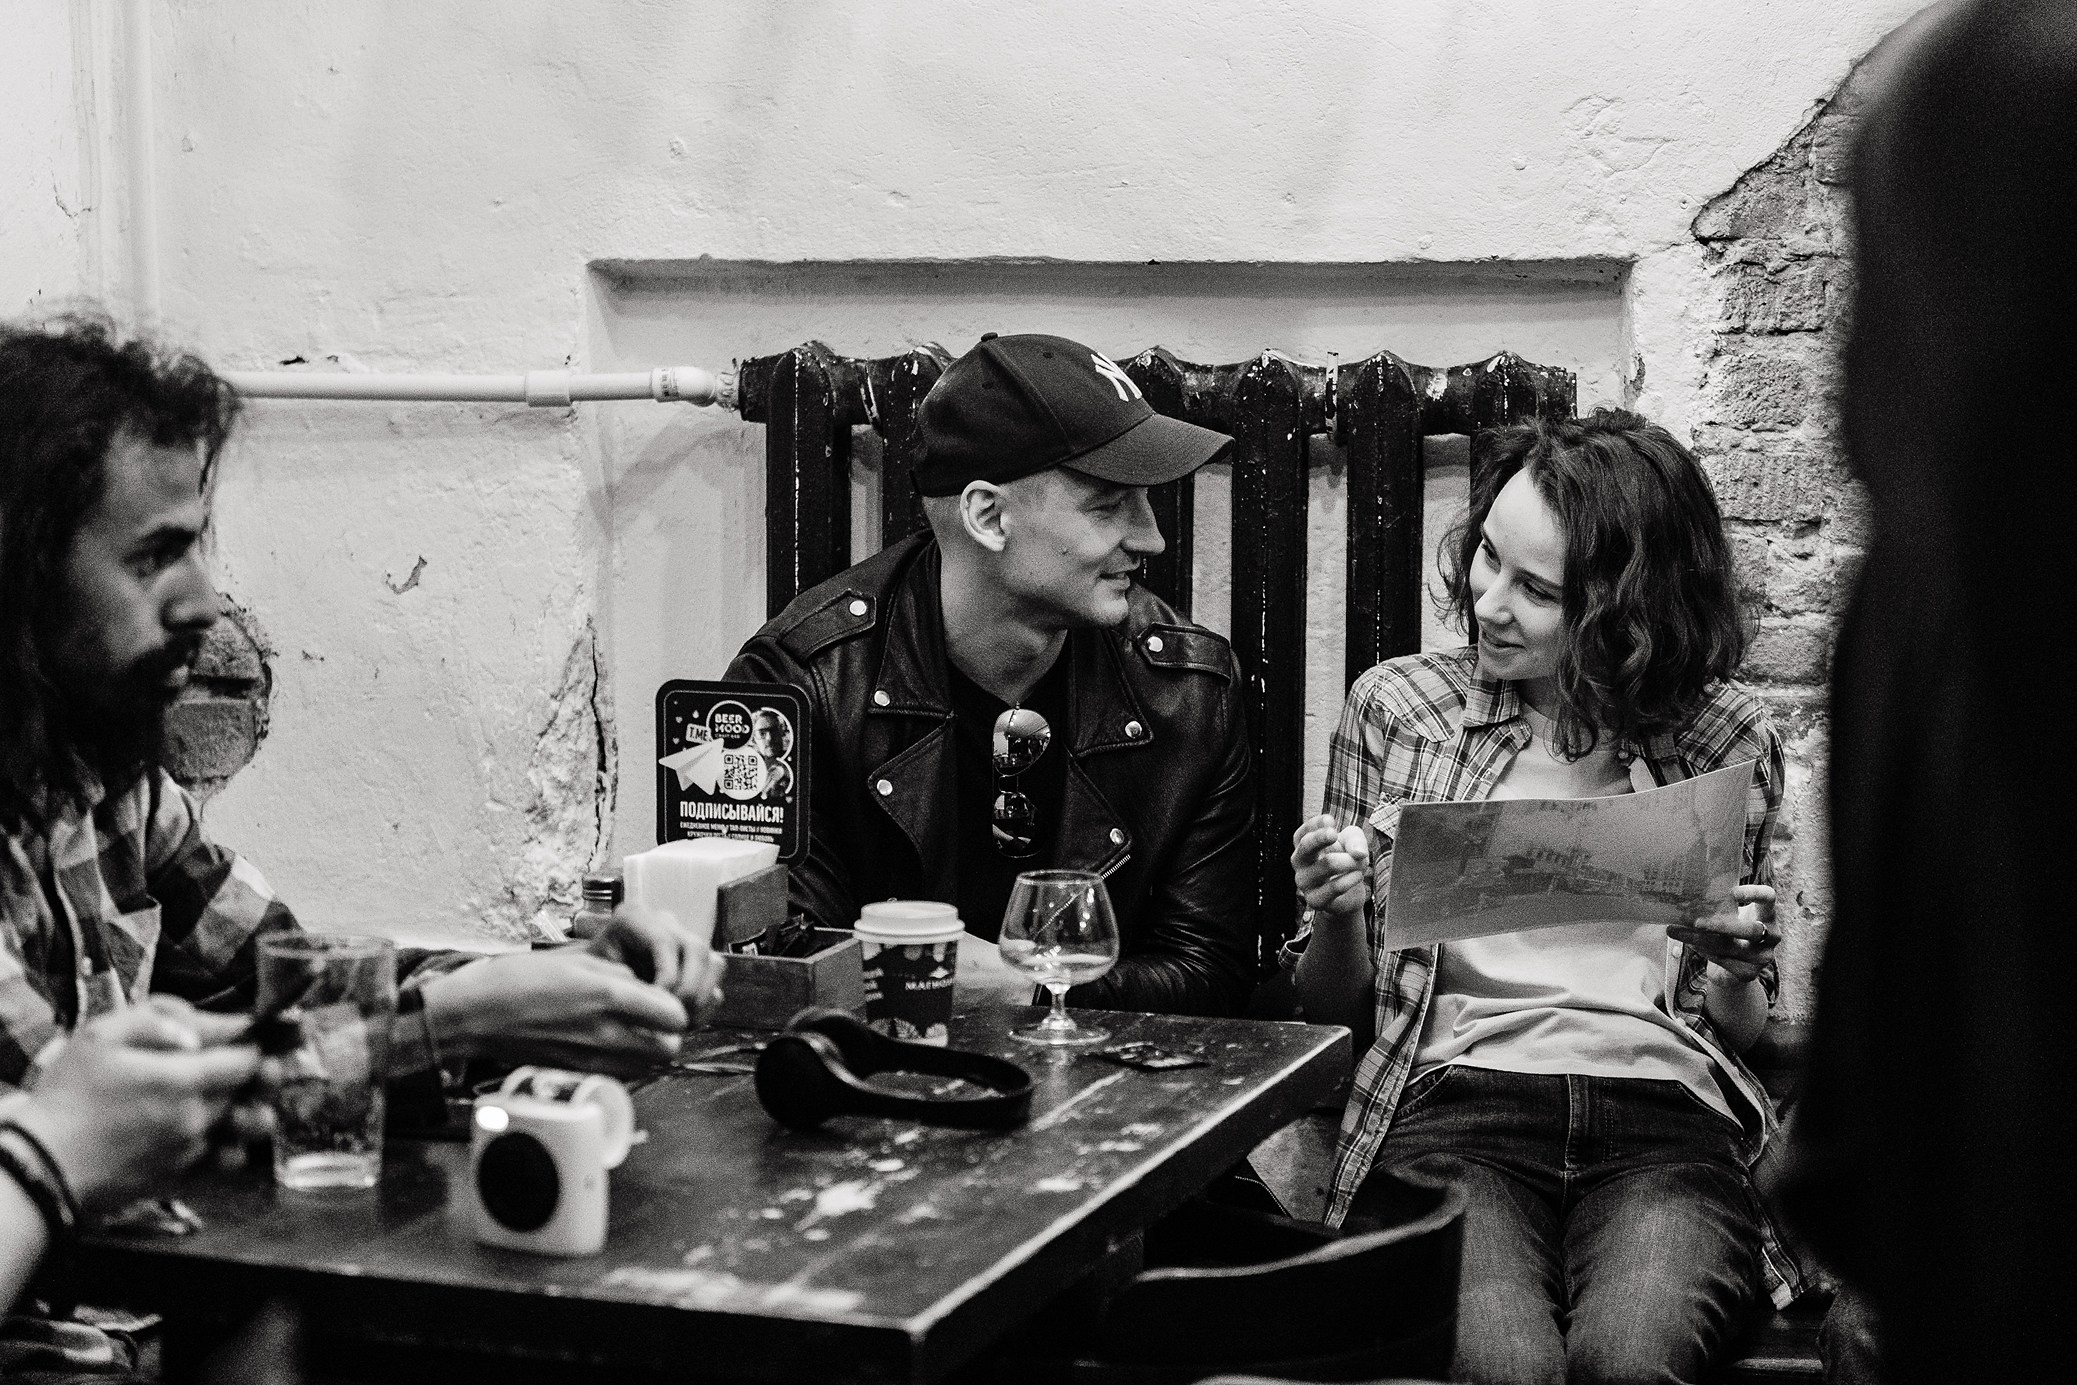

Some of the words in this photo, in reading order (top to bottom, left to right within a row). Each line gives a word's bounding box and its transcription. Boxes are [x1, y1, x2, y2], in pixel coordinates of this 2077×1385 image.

[714, 713, 743, 725] BEER
[689, 726, 712, 742] T.ME
[714, 723, 751, 735] MOOD
[680, 801, 784, 824] ПОДПИСЫВАЙСЯ!
[905, 977, 953, 991] МАГНОЛ
